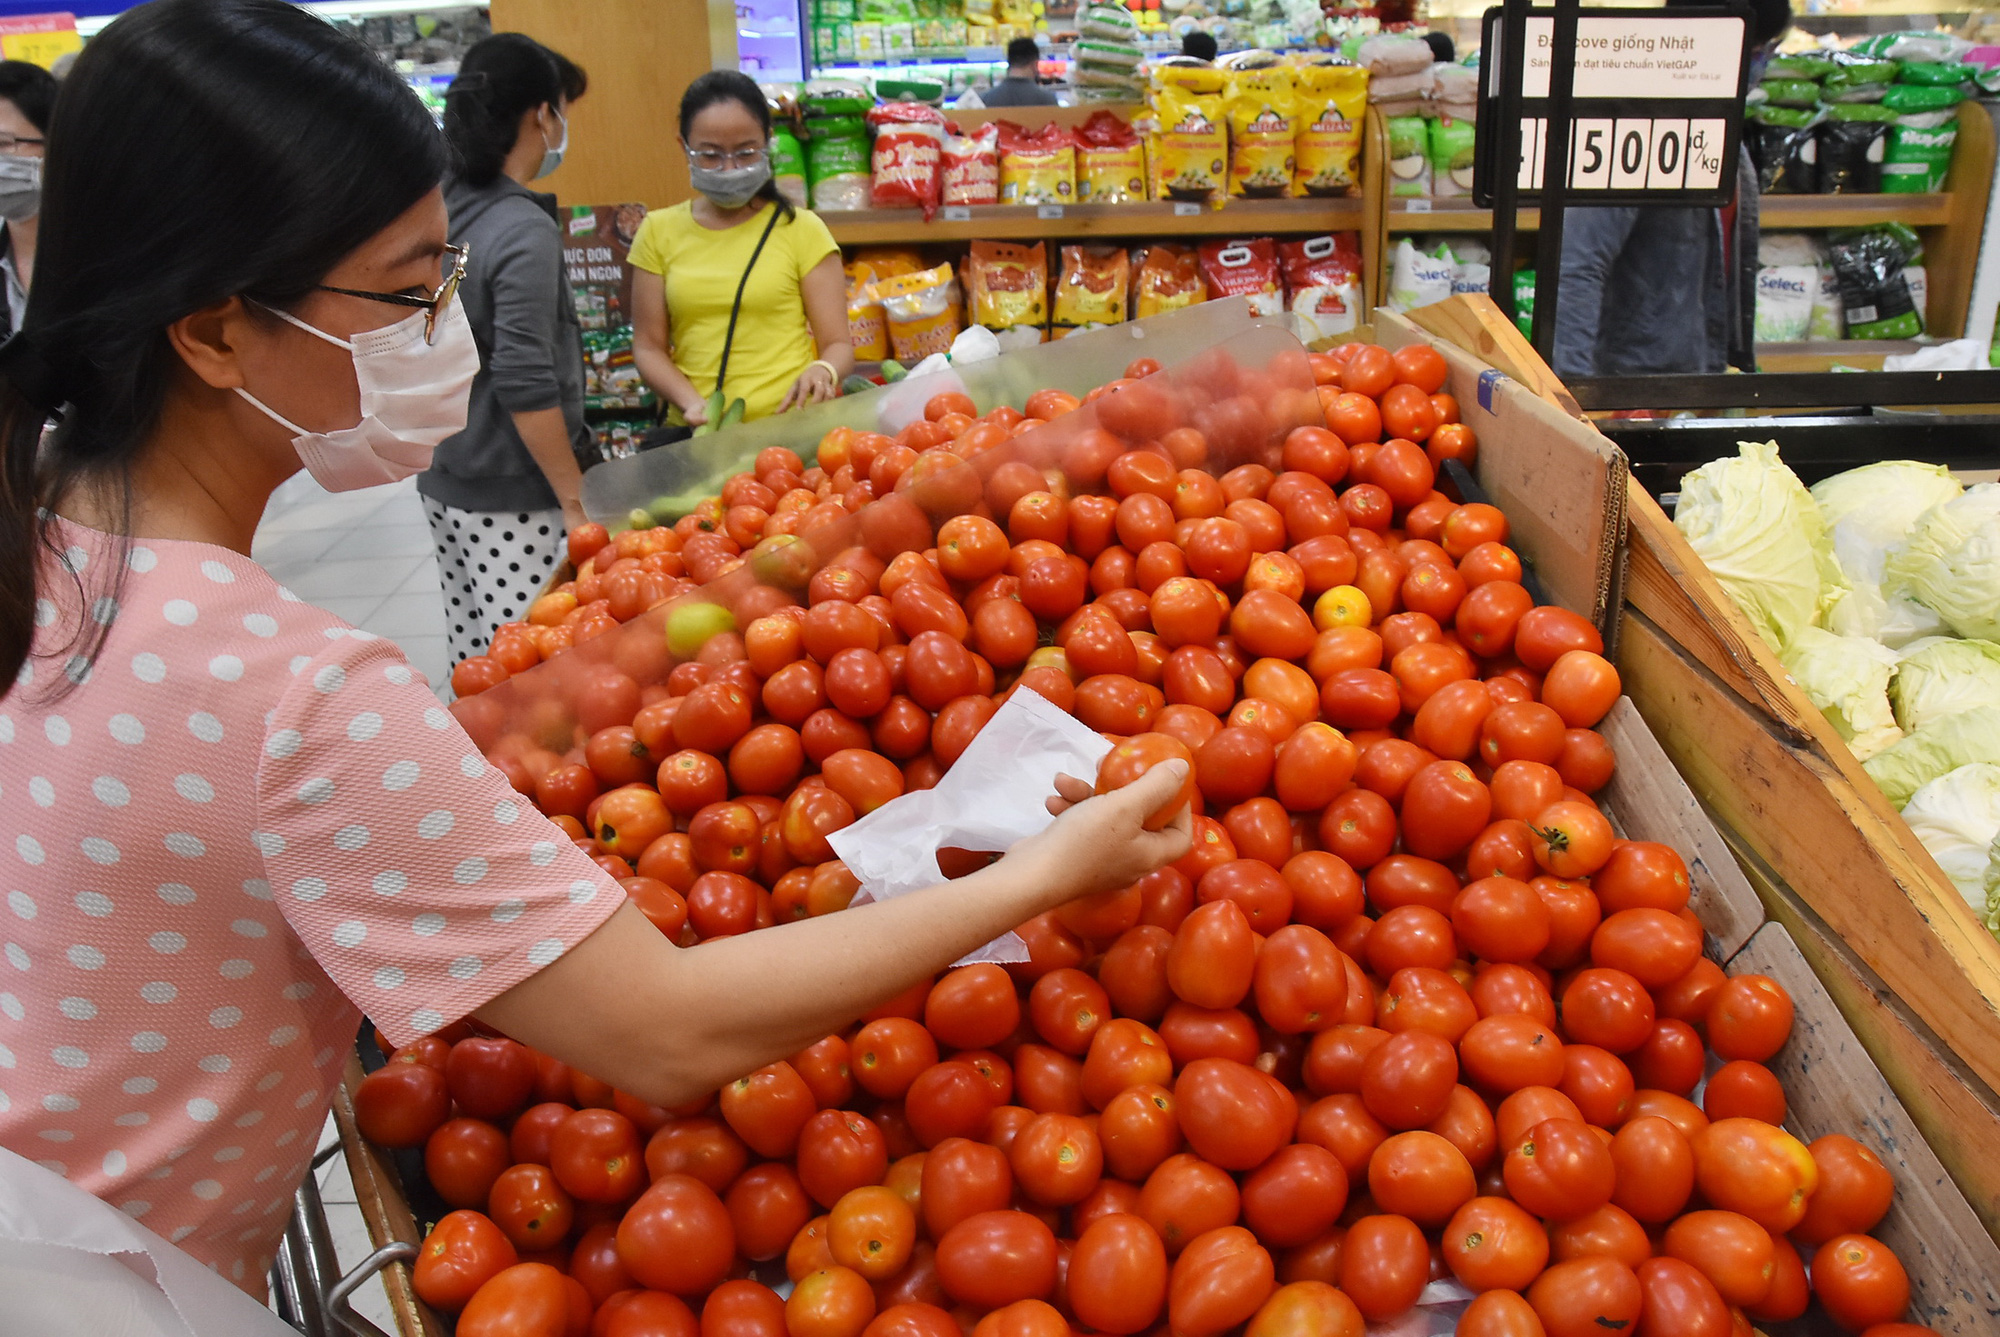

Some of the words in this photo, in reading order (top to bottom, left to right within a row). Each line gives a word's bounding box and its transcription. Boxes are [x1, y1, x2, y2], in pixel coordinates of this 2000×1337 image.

[1613, 33, 1655, 52] giống
[1660, 36, 1694, 53] Nhật
[1584, 59, 1599, 70] đạt
[1602, 59, 1620, 68] tiêu
[1657, 60, 1698, 69] VietGAP
[1759, 276, 1805, 292] Select
